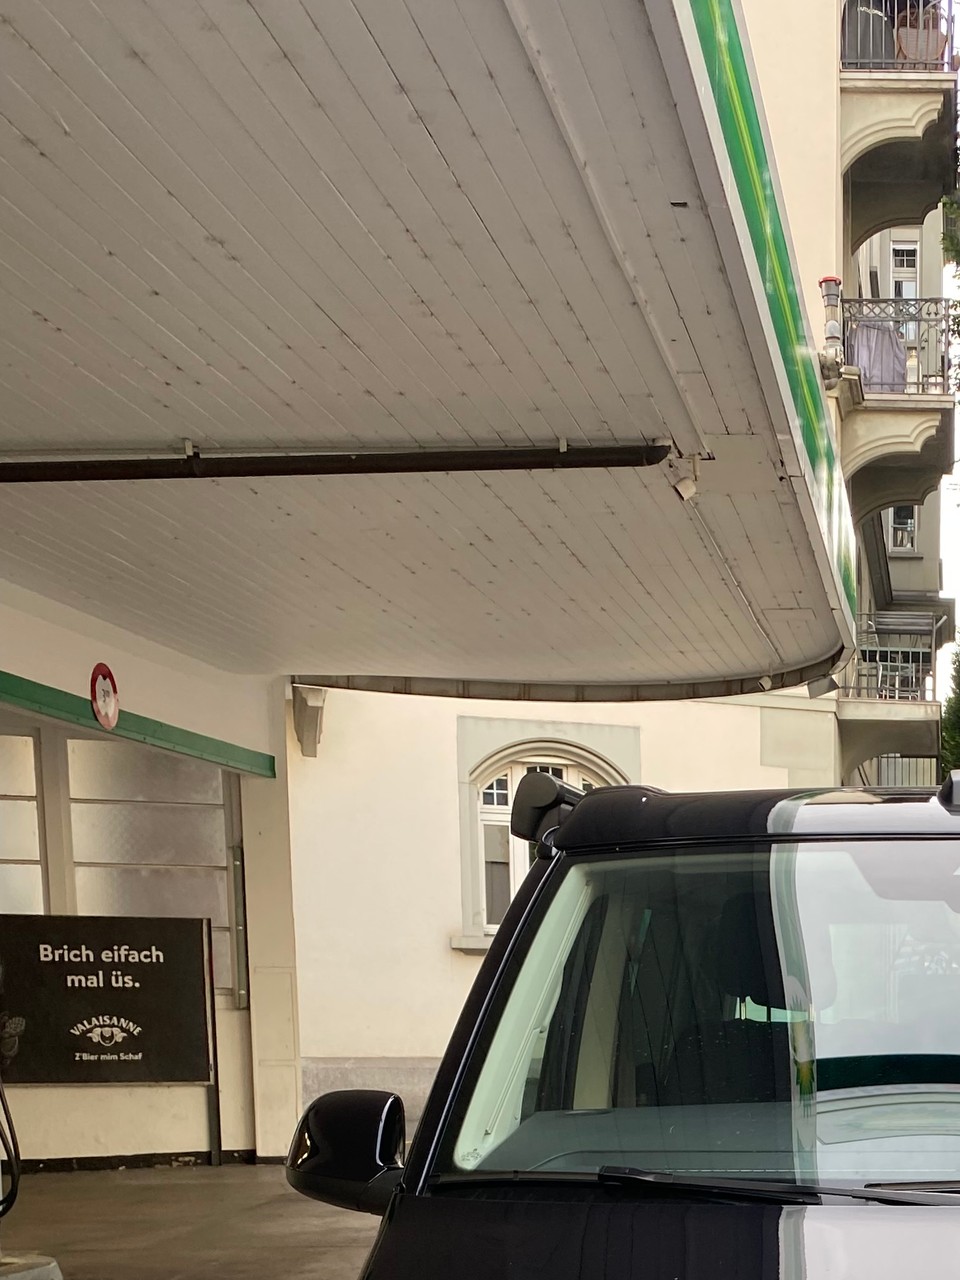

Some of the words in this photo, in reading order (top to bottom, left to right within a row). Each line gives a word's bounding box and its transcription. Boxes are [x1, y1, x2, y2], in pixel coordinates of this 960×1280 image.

[39, 944, 94, 962] Brich
[101, 945, 164, 963] eifach
[66, 970, 104, 987] mal
[111, 970, 140, 987] üs.
[69, 1015, 142, 1036] VALAISANNE
[100, 1052, 118, 1061] mim
[120, 1052, 143, 1061] Schaf
